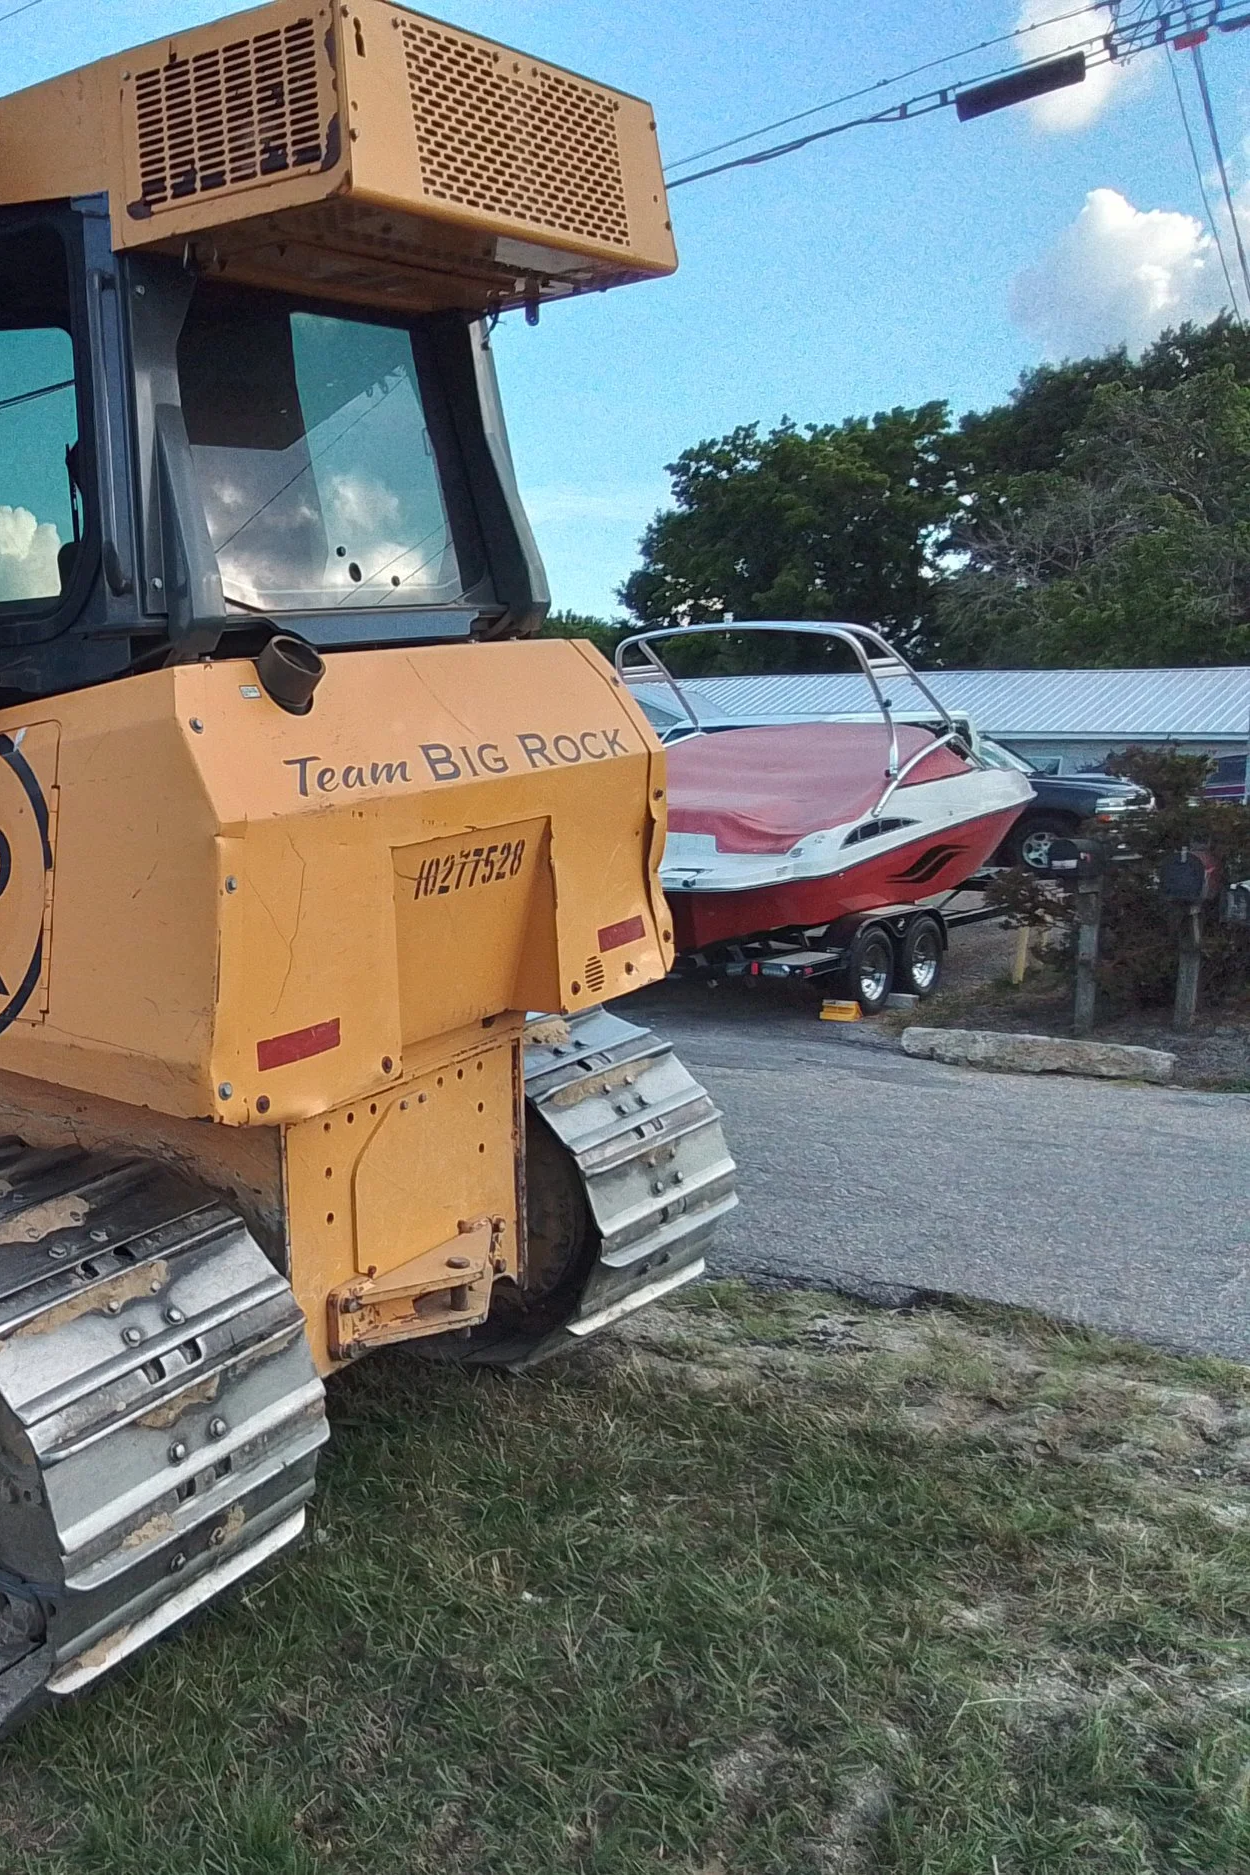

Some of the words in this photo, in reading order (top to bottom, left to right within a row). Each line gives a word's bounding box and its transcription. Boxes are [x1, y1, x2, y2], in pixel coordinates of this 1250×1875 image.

[282, 755, 412, 797] Team
[419, 742, 509, 782] BIG
[516, 728, 630, 769] ROCK
[413, 839, 526, 901] 10277528
